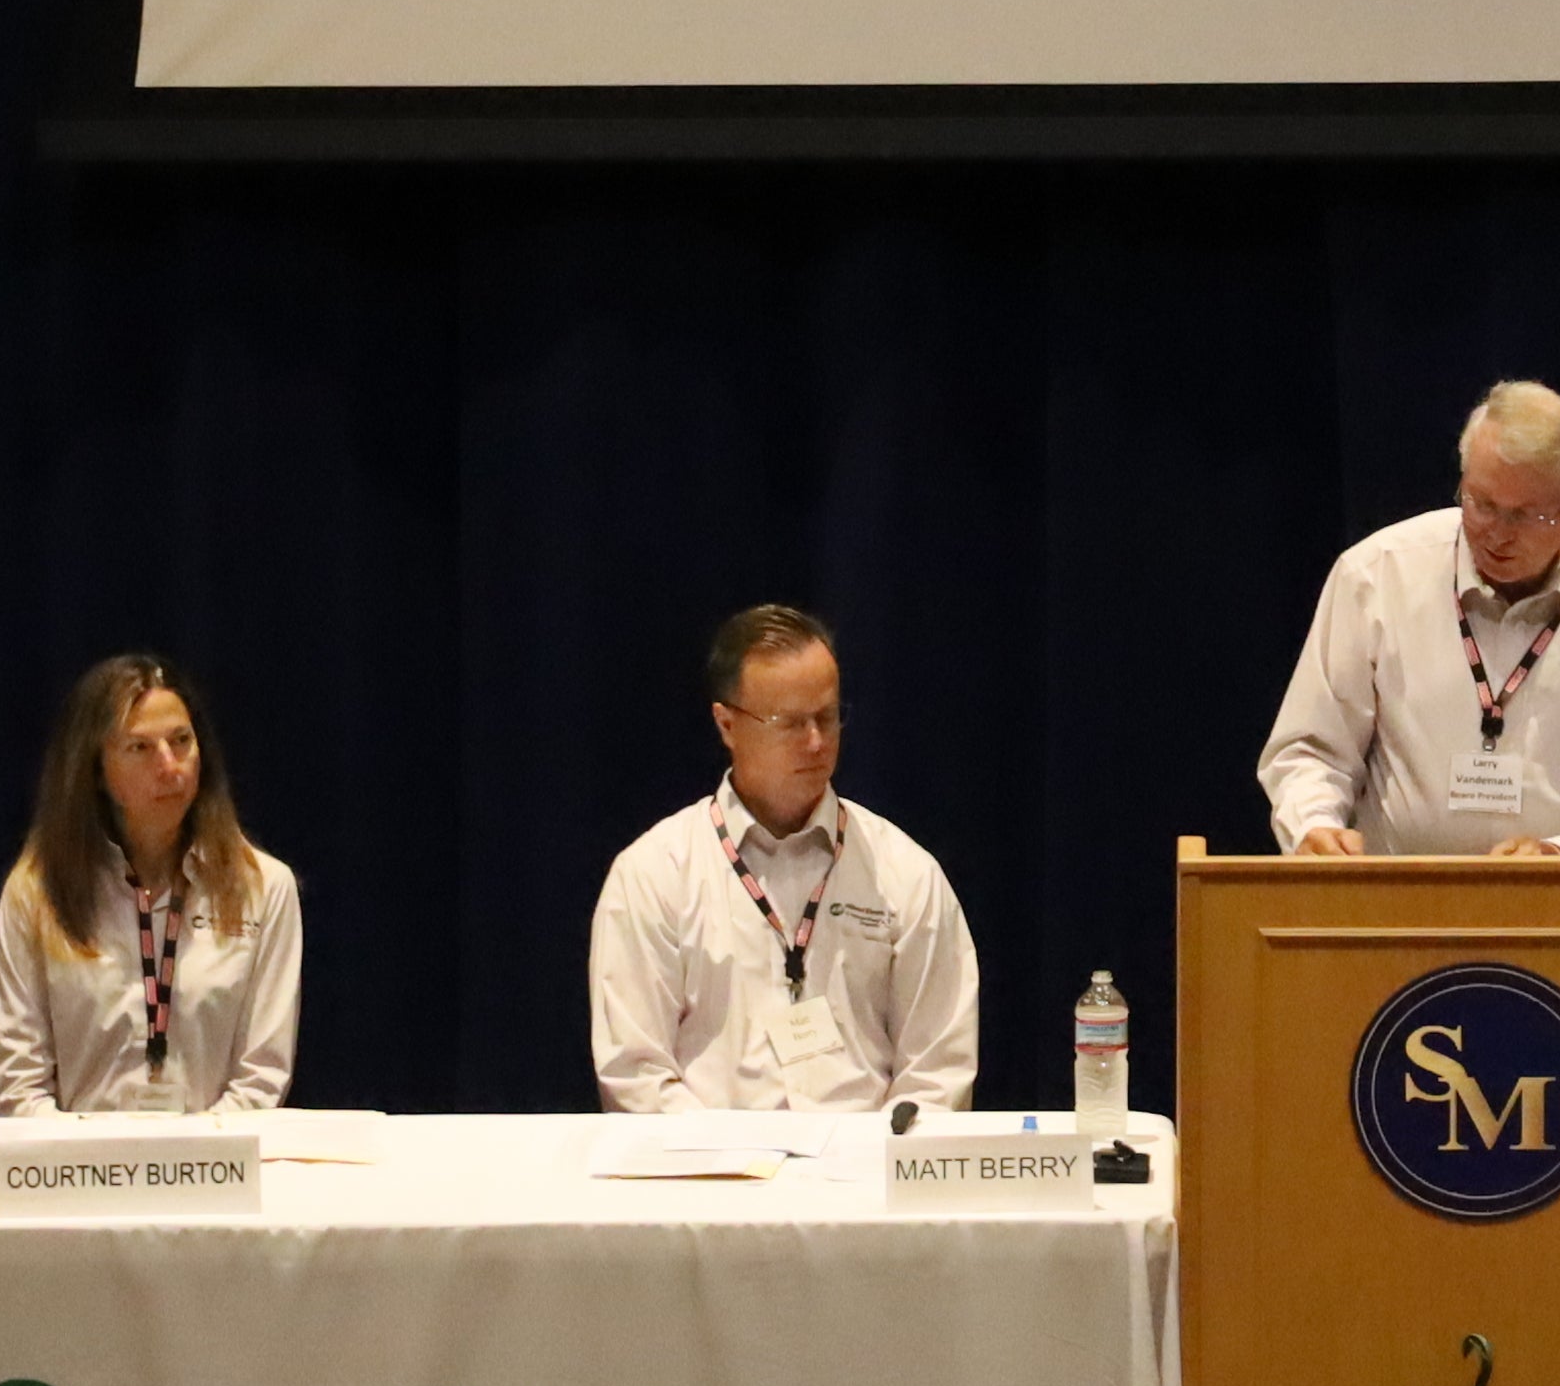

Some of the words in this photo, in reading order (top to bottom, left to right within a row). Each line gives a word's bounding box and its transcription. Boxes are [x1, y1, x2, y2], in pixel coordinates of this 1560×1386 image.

[1404, 1024, 1557, 1151] SM
[6, 1163, 139, 1189] COURTNEY
[146, 1160, 245, 1186] BURTON
[895, 1157, 971, 1181] MATT
[979, 1155, 1078, 1180] BERRY
